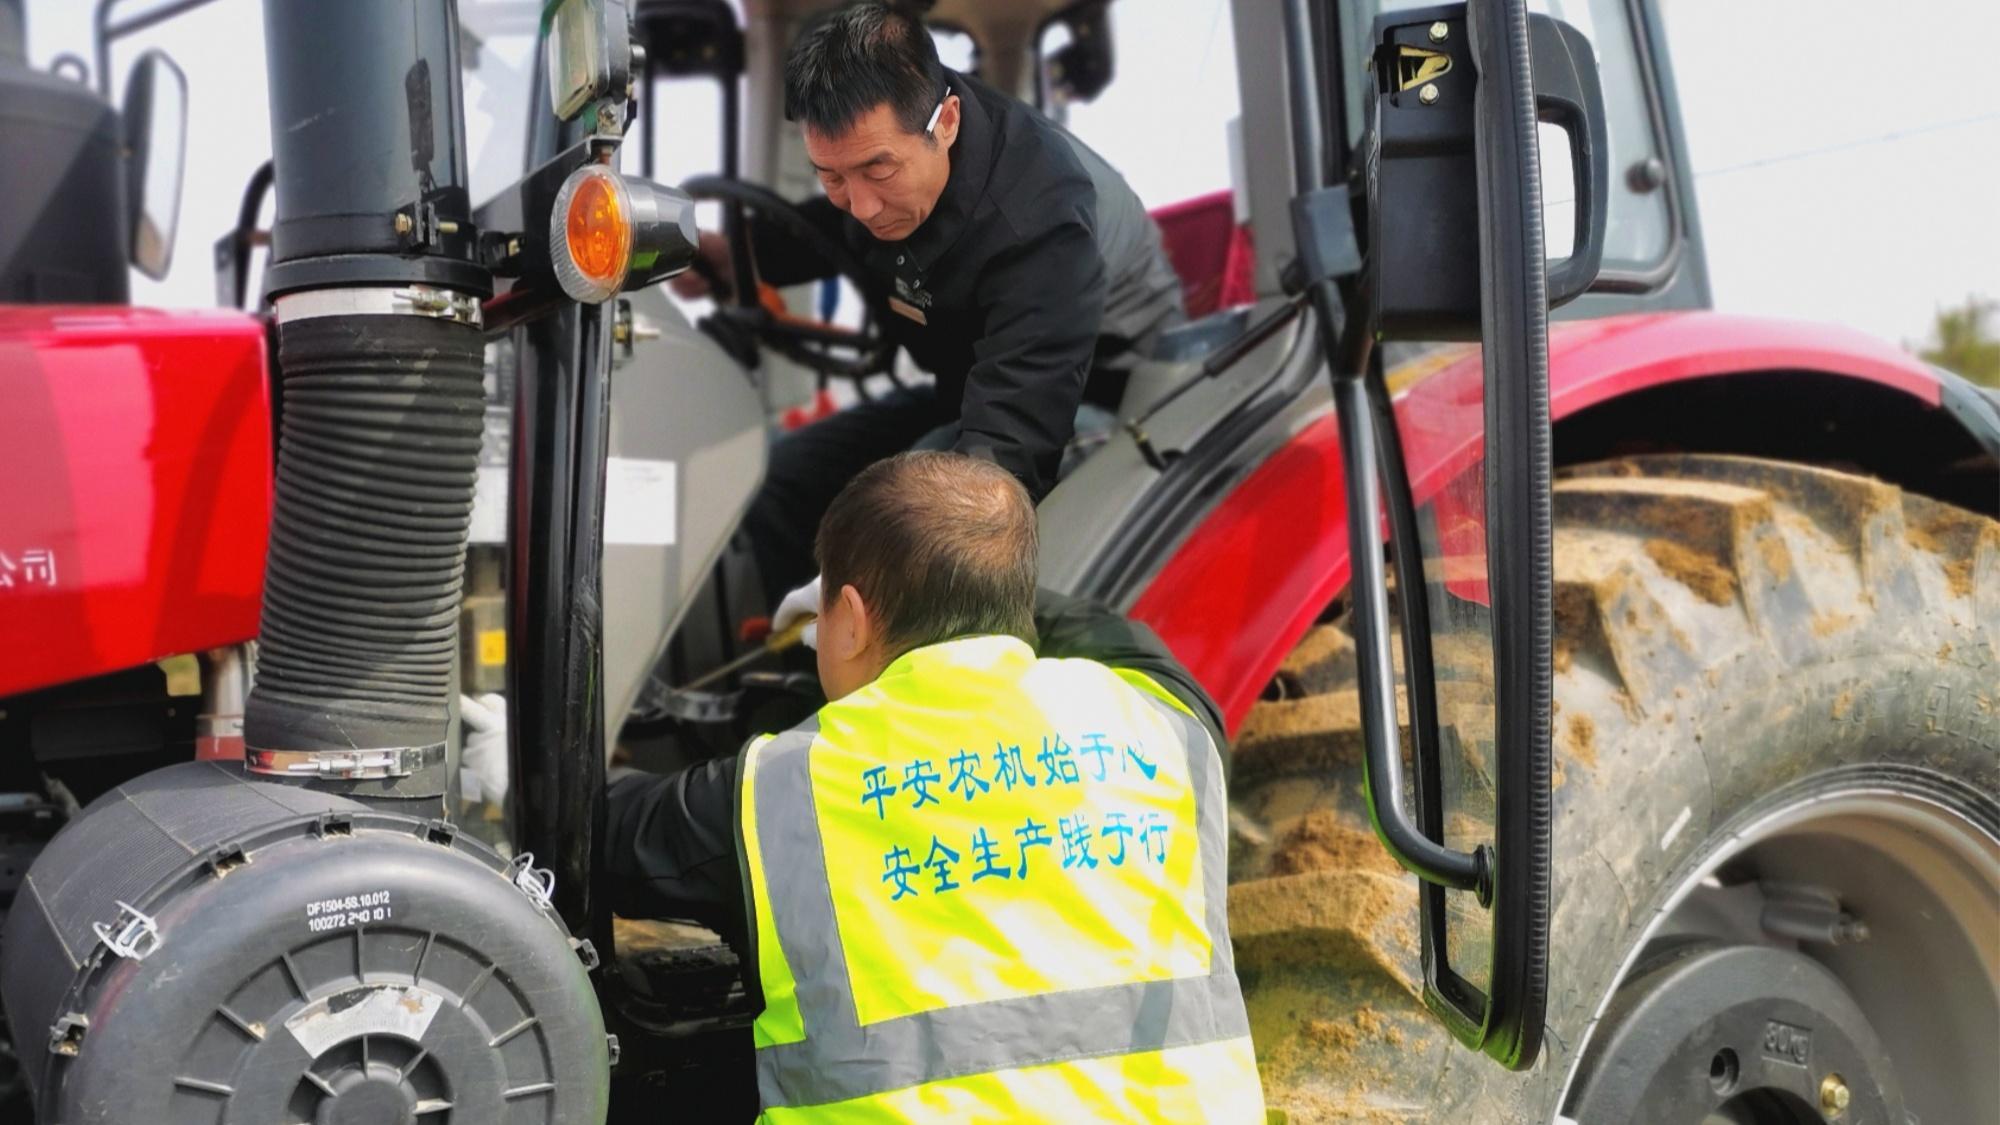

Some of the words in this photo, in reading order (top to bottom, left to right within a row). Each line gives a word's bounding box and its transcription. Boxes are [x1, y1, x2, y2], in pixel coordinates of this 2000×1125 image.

[861, 733, 1158, 820] 平安农机始于心
[882, 812, 1168, 901] 安全生产践于行
[308, 913, 346, 932] 100272
